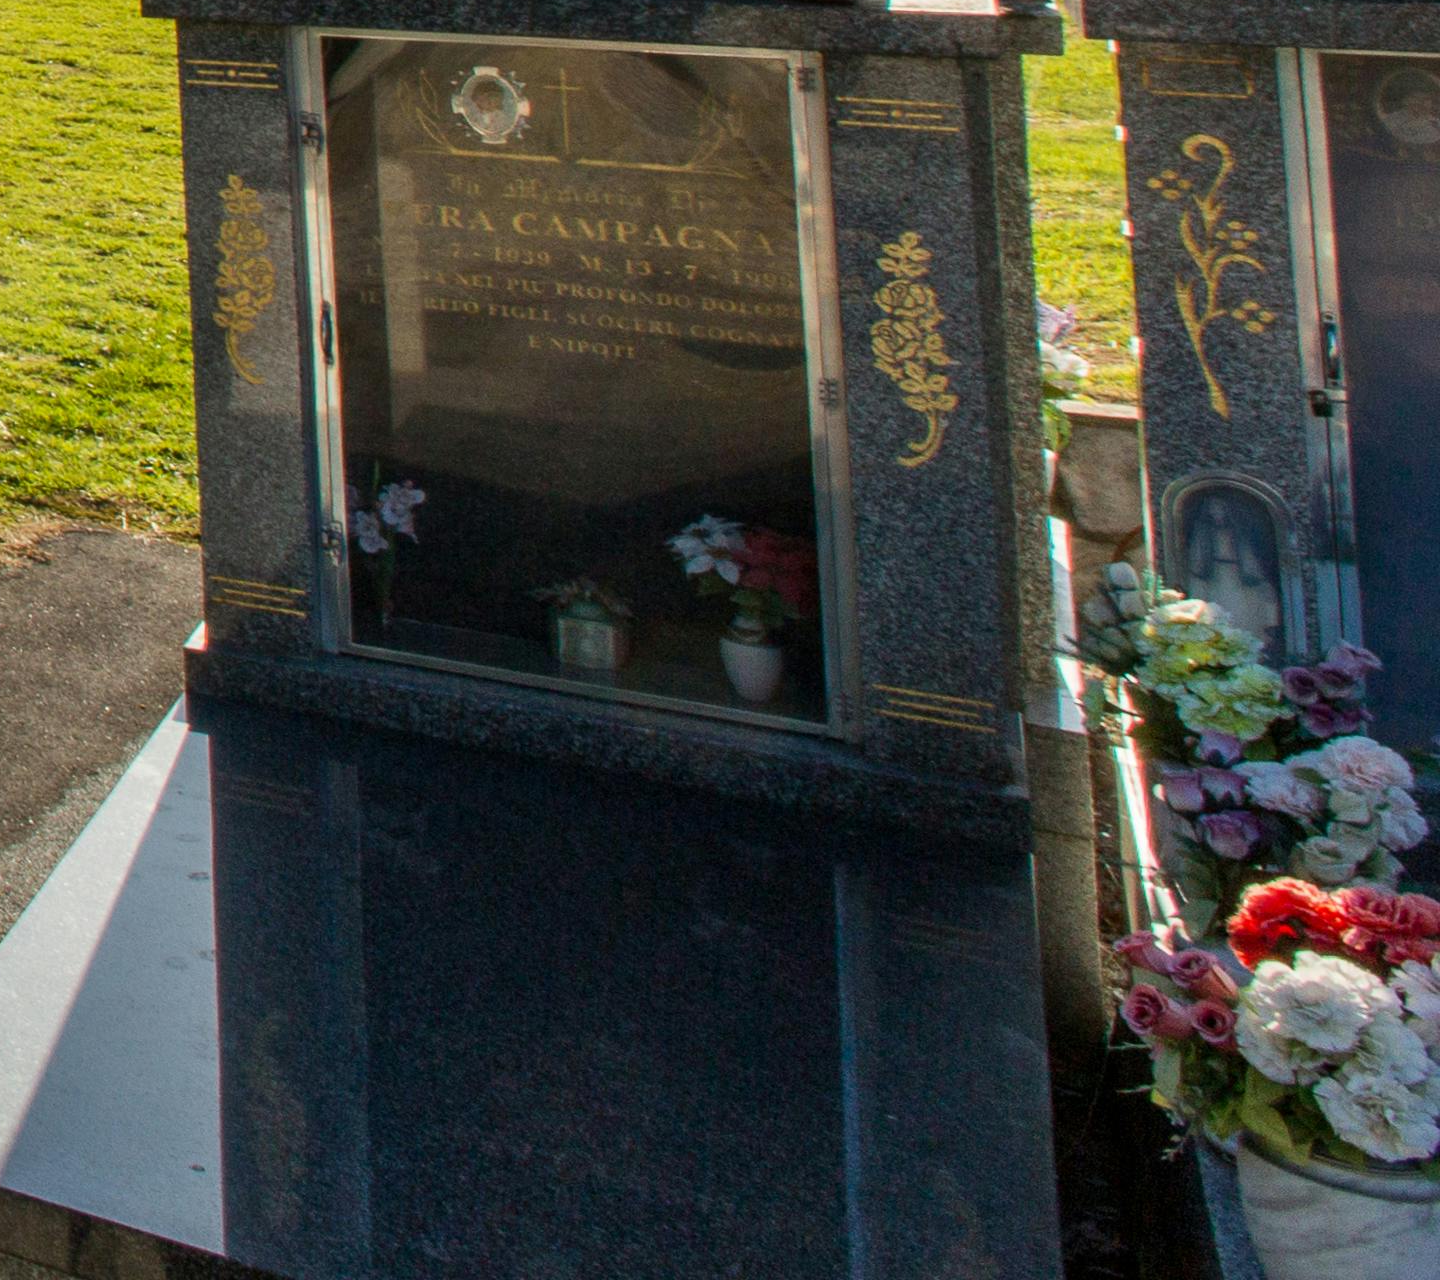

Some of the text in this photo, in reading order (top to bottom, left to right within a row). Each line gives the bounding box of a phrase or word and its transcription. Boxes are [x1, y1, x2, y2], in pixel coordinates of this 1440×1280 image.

[511, 211, 776, 257] CAMPAGNA
[391, 294, 481, 315] RITO
[554, 281, 692, 309] PROFONDO
